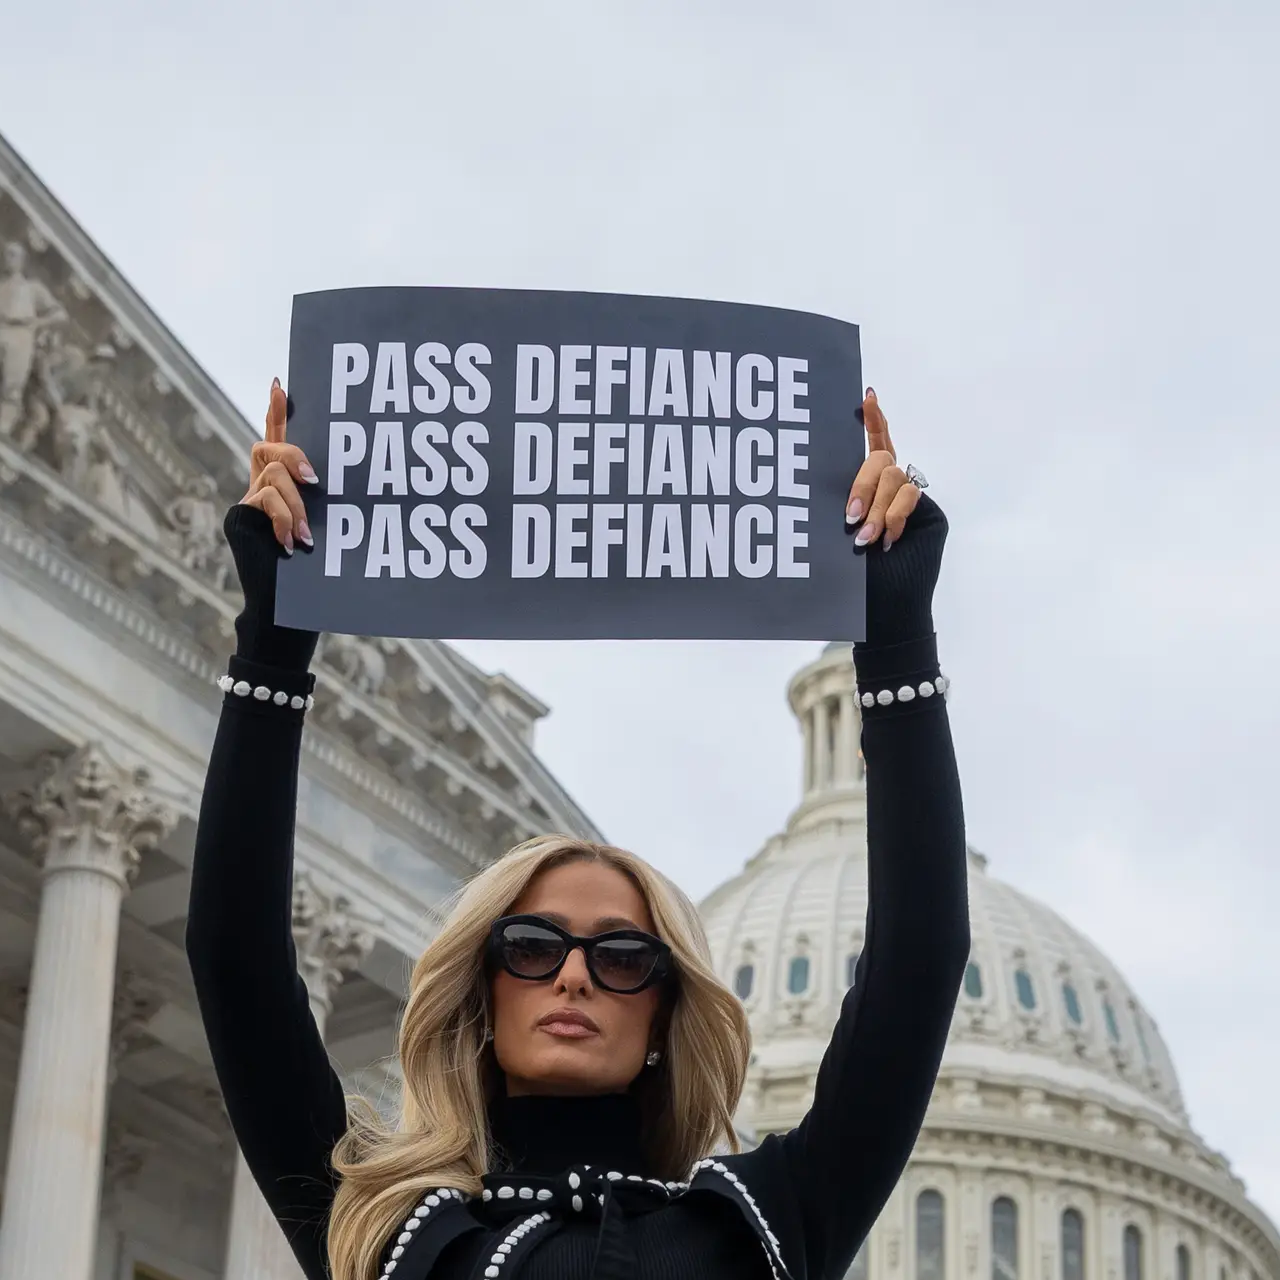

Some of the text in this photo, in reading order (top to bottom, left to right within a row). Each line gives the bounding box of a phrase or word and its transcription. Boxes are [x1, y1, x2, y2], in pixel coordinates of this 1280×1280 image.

[329, 342, 811, 423] PASS DEFIANCE
[327, 421, 811, 500] PASS DEFIANCE
[324, 503, 811, 579] PASS DEFIANCE
